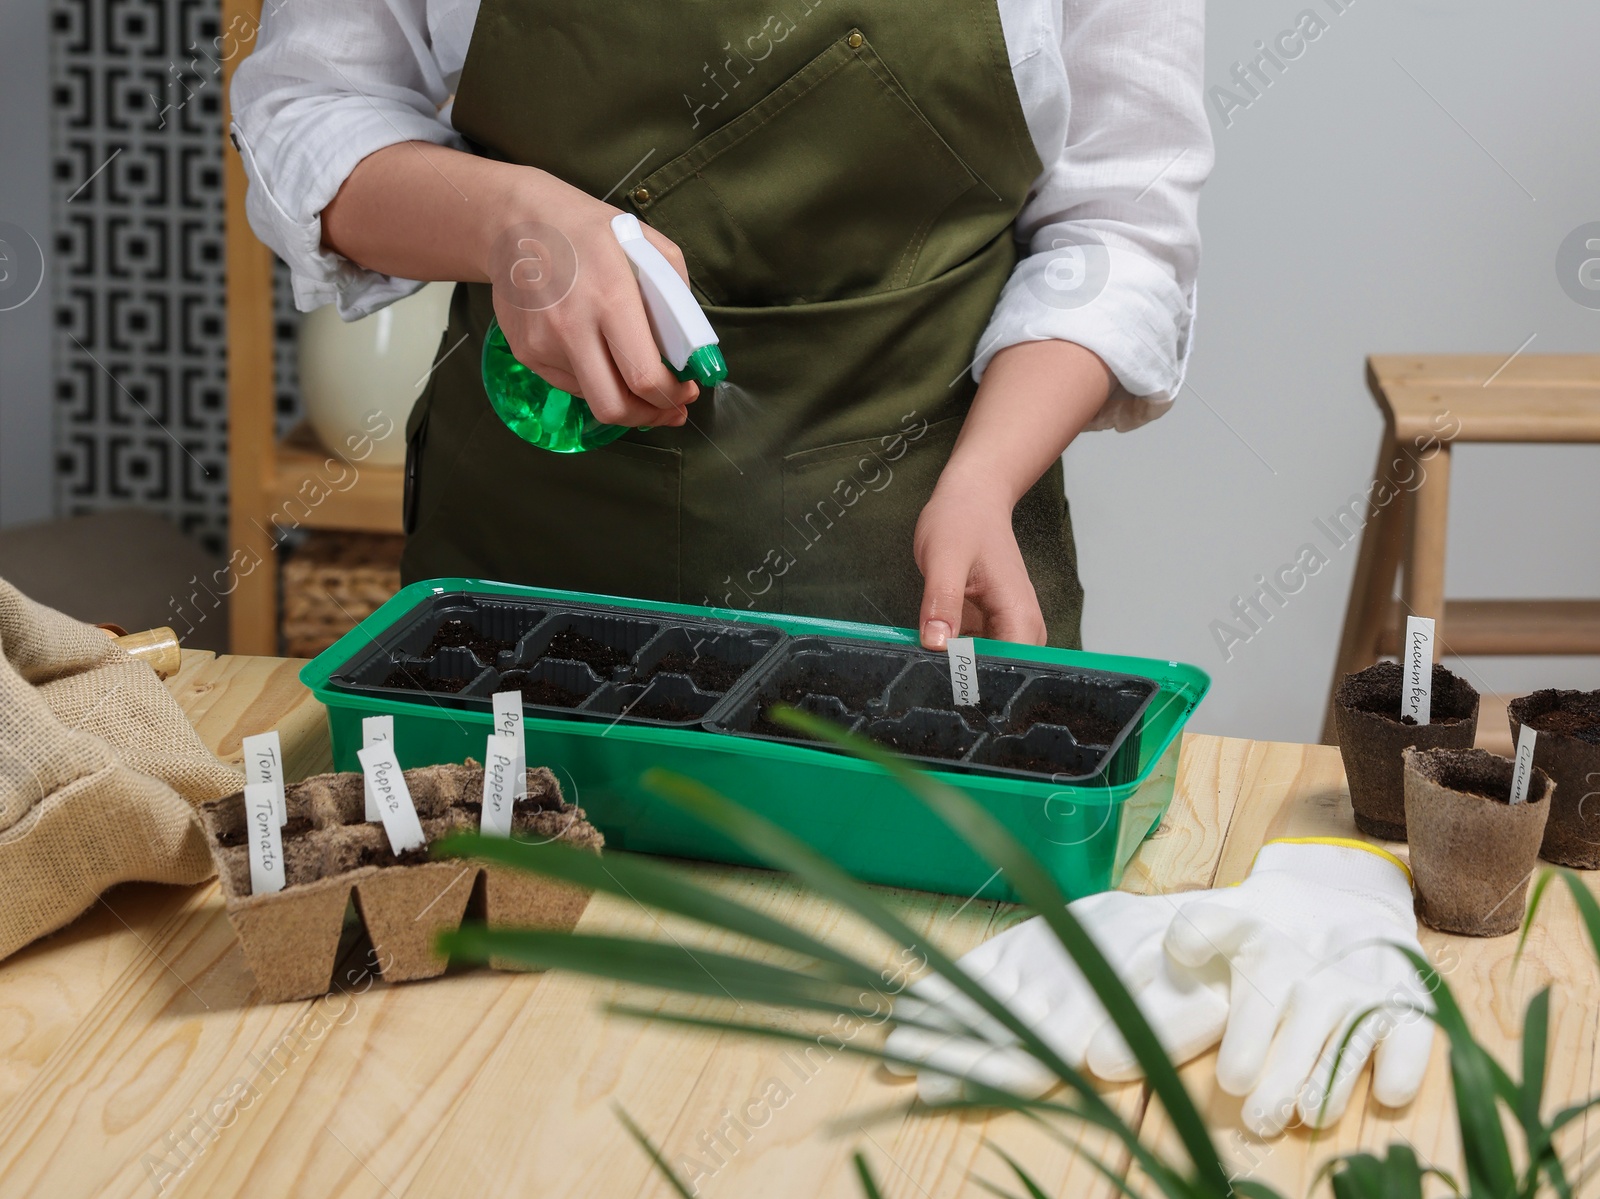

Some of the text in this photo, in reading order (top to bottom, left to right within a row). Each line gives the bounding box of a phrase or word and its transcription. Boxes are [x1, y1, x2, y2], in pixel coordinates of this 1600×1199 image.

[954, 654, 972, 704] Pepper
[1410, 631, 1429, 714] Cucumber
[373, 761, 399, 814] Pepper
[490, 754, 511, 812] Pepper
[256, 799, 277, 872] Tomato
